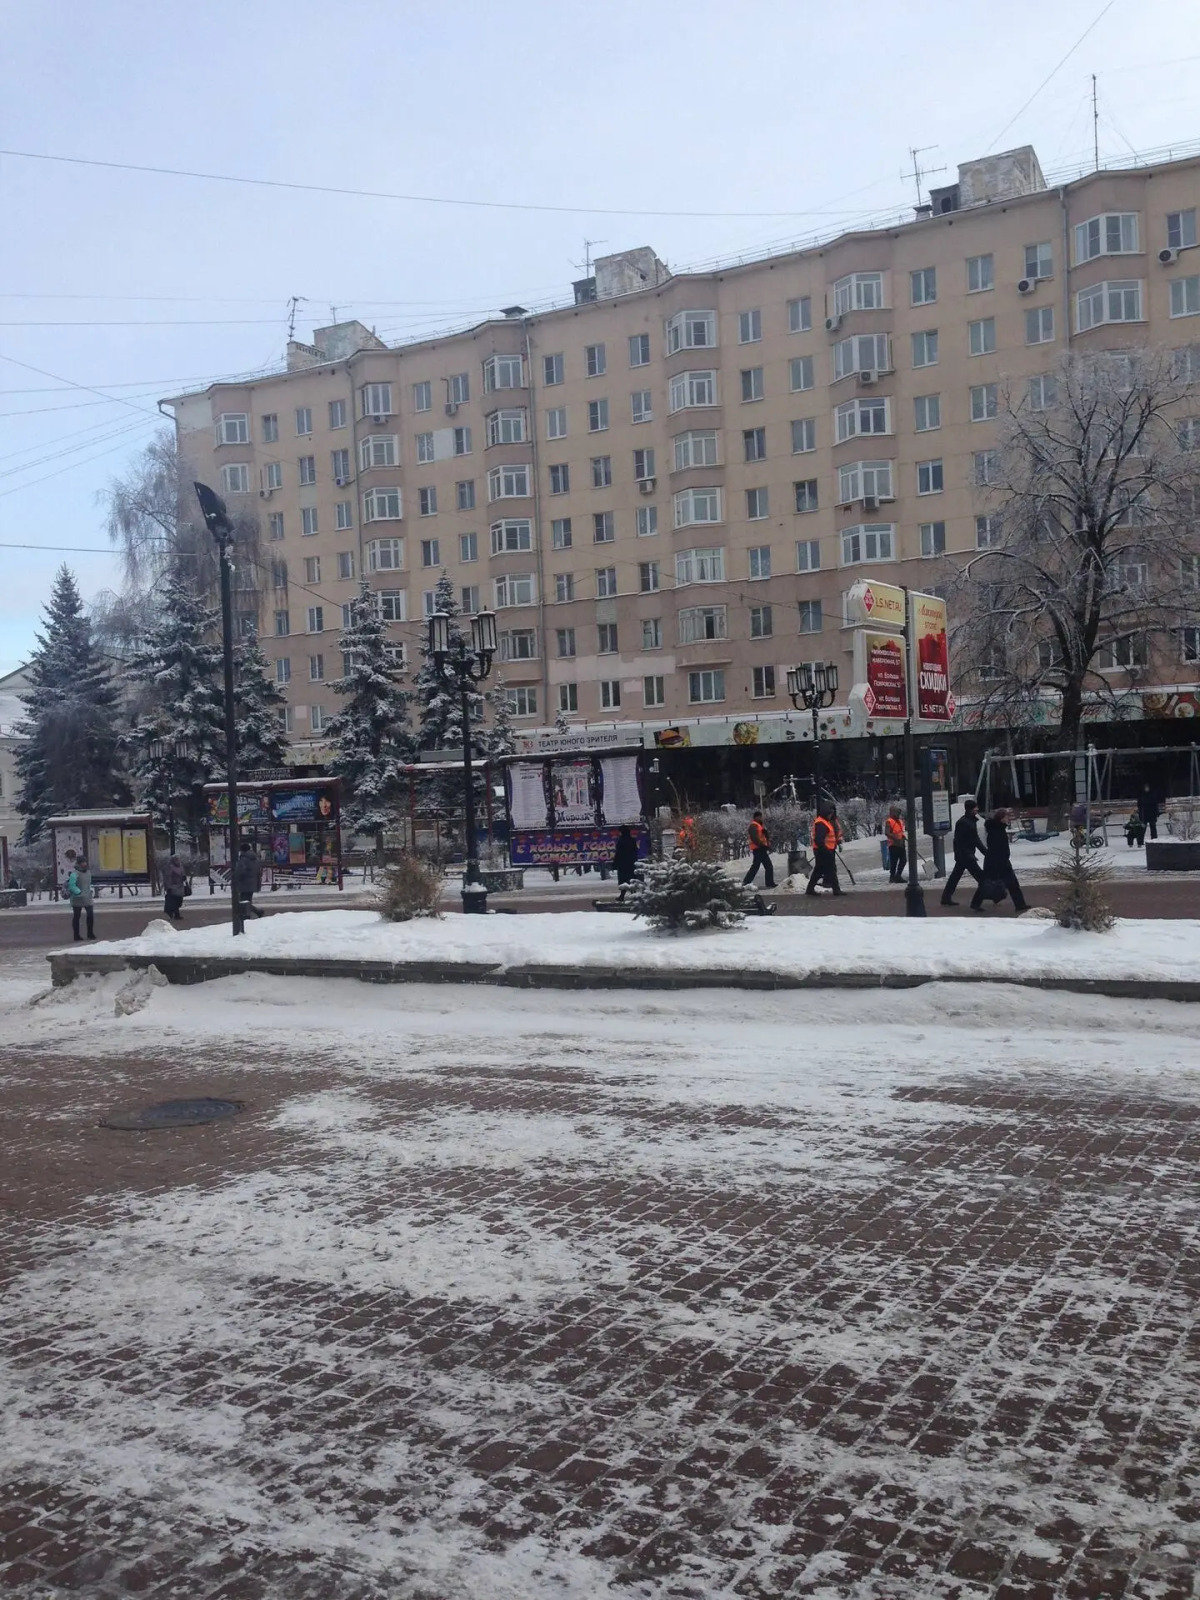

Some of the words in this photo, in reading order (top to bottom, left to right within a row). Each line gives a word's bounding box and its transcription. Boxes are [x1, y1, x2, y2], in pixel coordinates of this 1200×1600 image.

[920, 671, 947, 693] СКИДКИ
[587, 735, 618, 743] ЗРИТЕЛЯ
[583, 841, 616, 850] ГОДО
